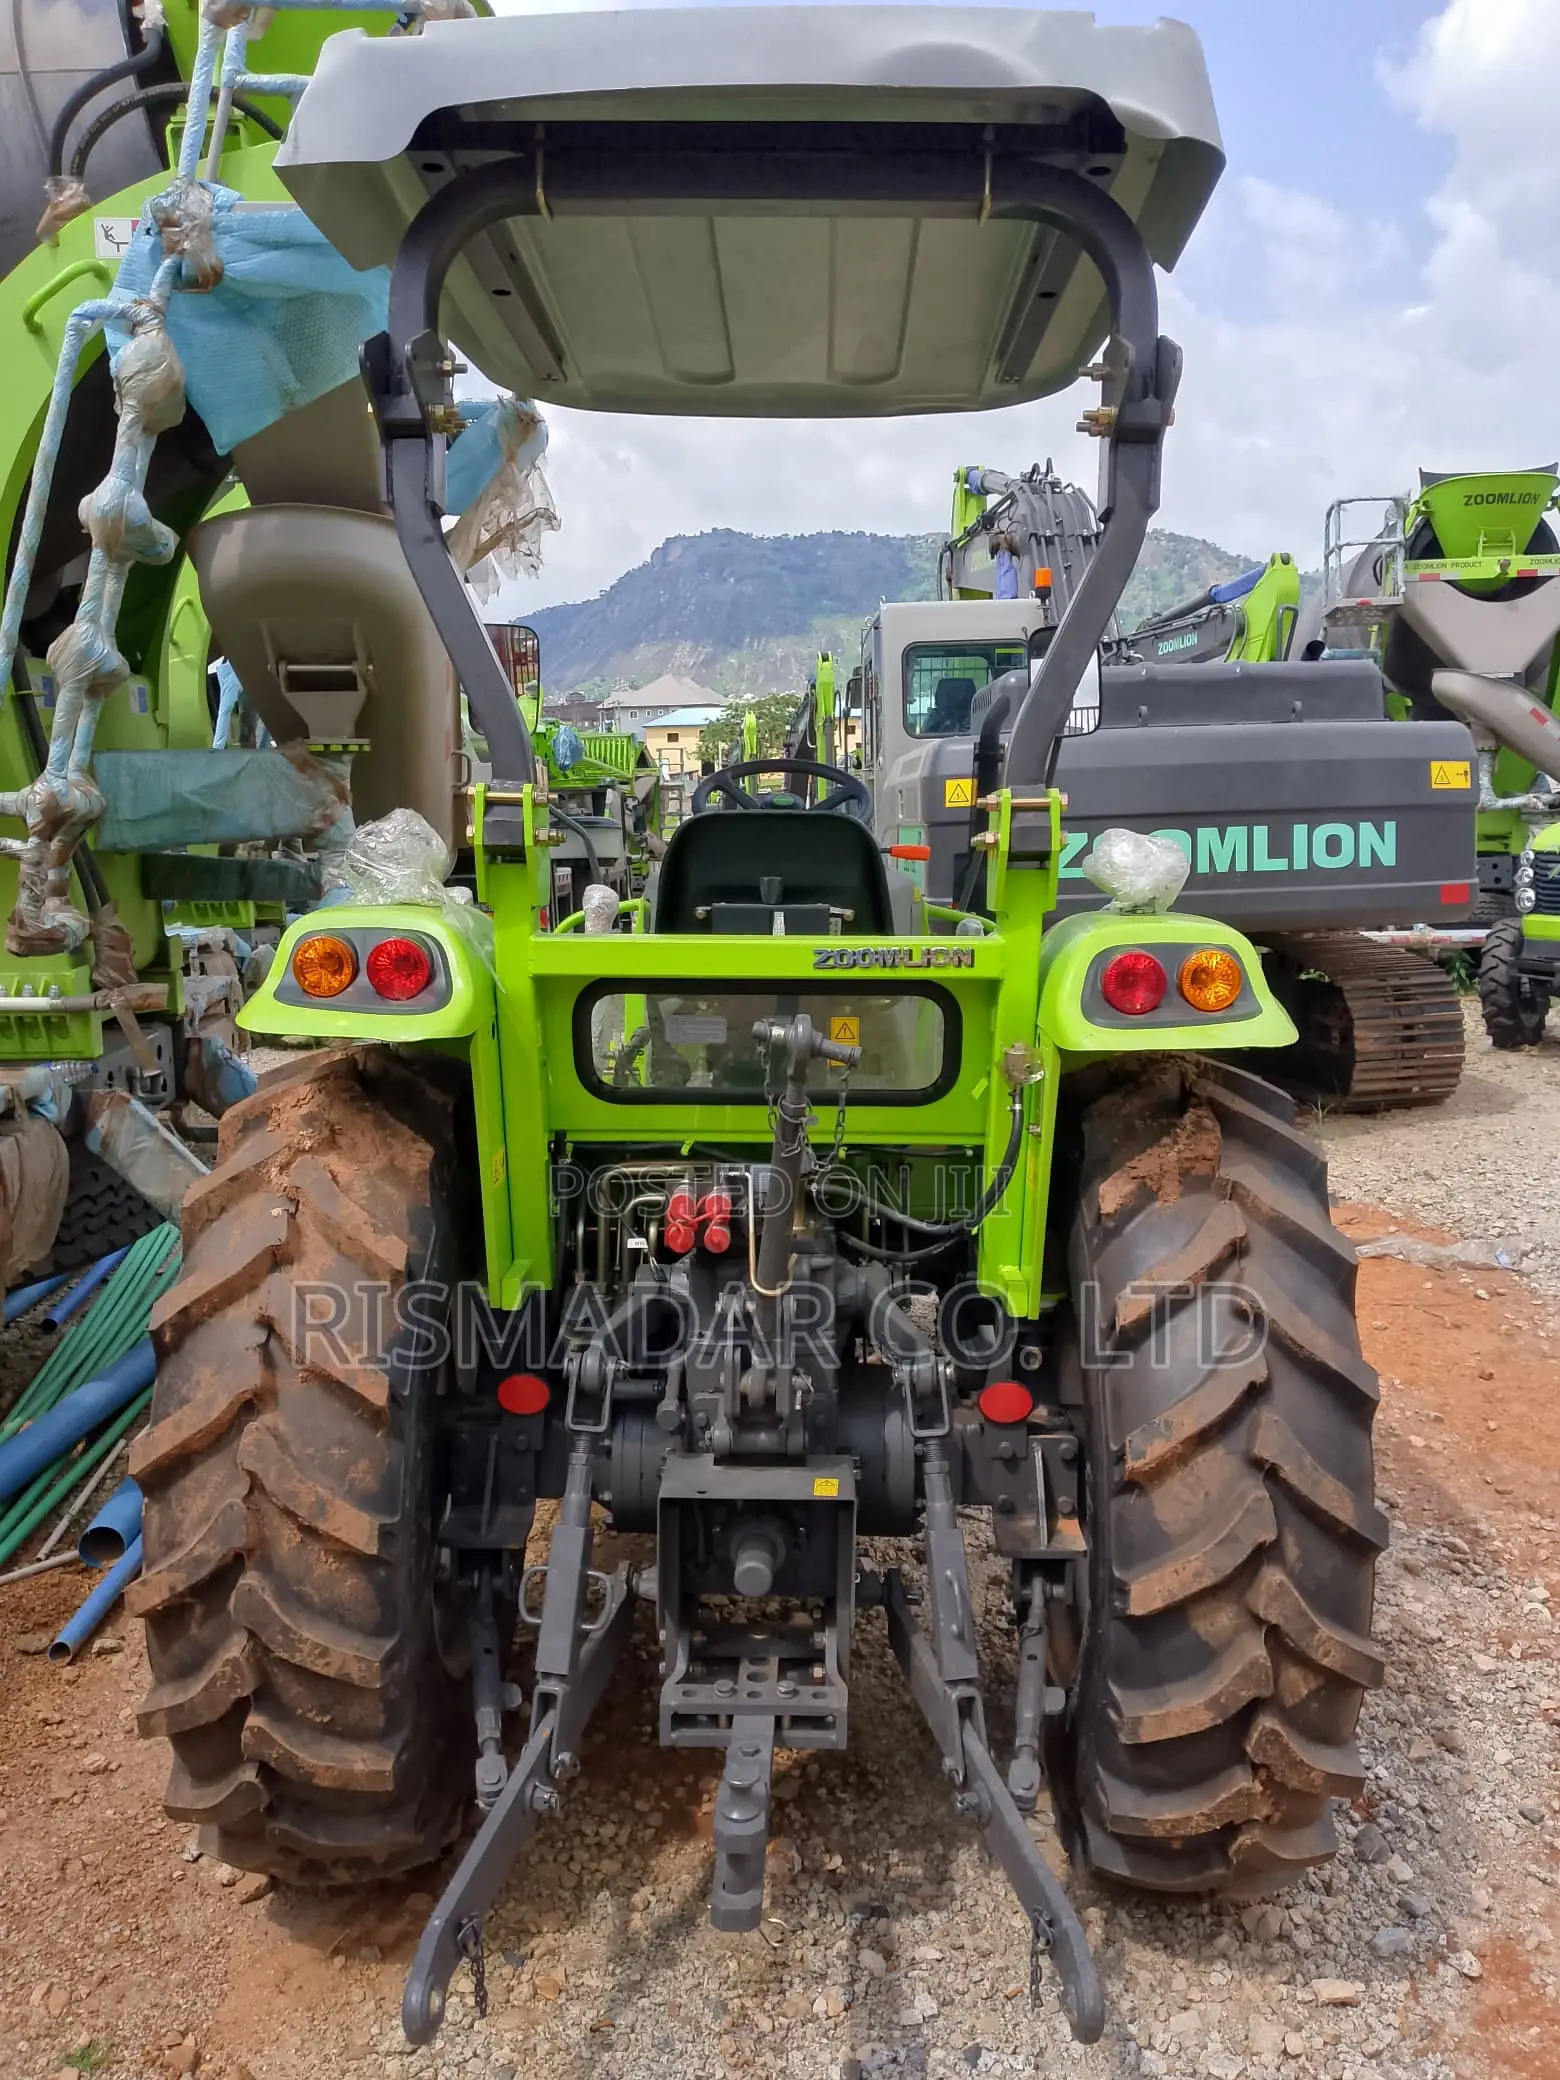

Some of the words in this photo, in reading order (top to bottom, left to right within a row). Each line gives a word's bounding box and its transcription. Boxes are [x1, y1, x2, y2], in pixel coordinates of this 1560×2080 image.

[1463, 492, 1541, 506] ZOOMLION
[1450, 561, 1482, 569] PRODUCT
[1157, 631, 1198, 656] ZOOMLION
[1058, 820, 1397, 879] ZMLION
[813, 946, 975, 969] ZOOMLION
